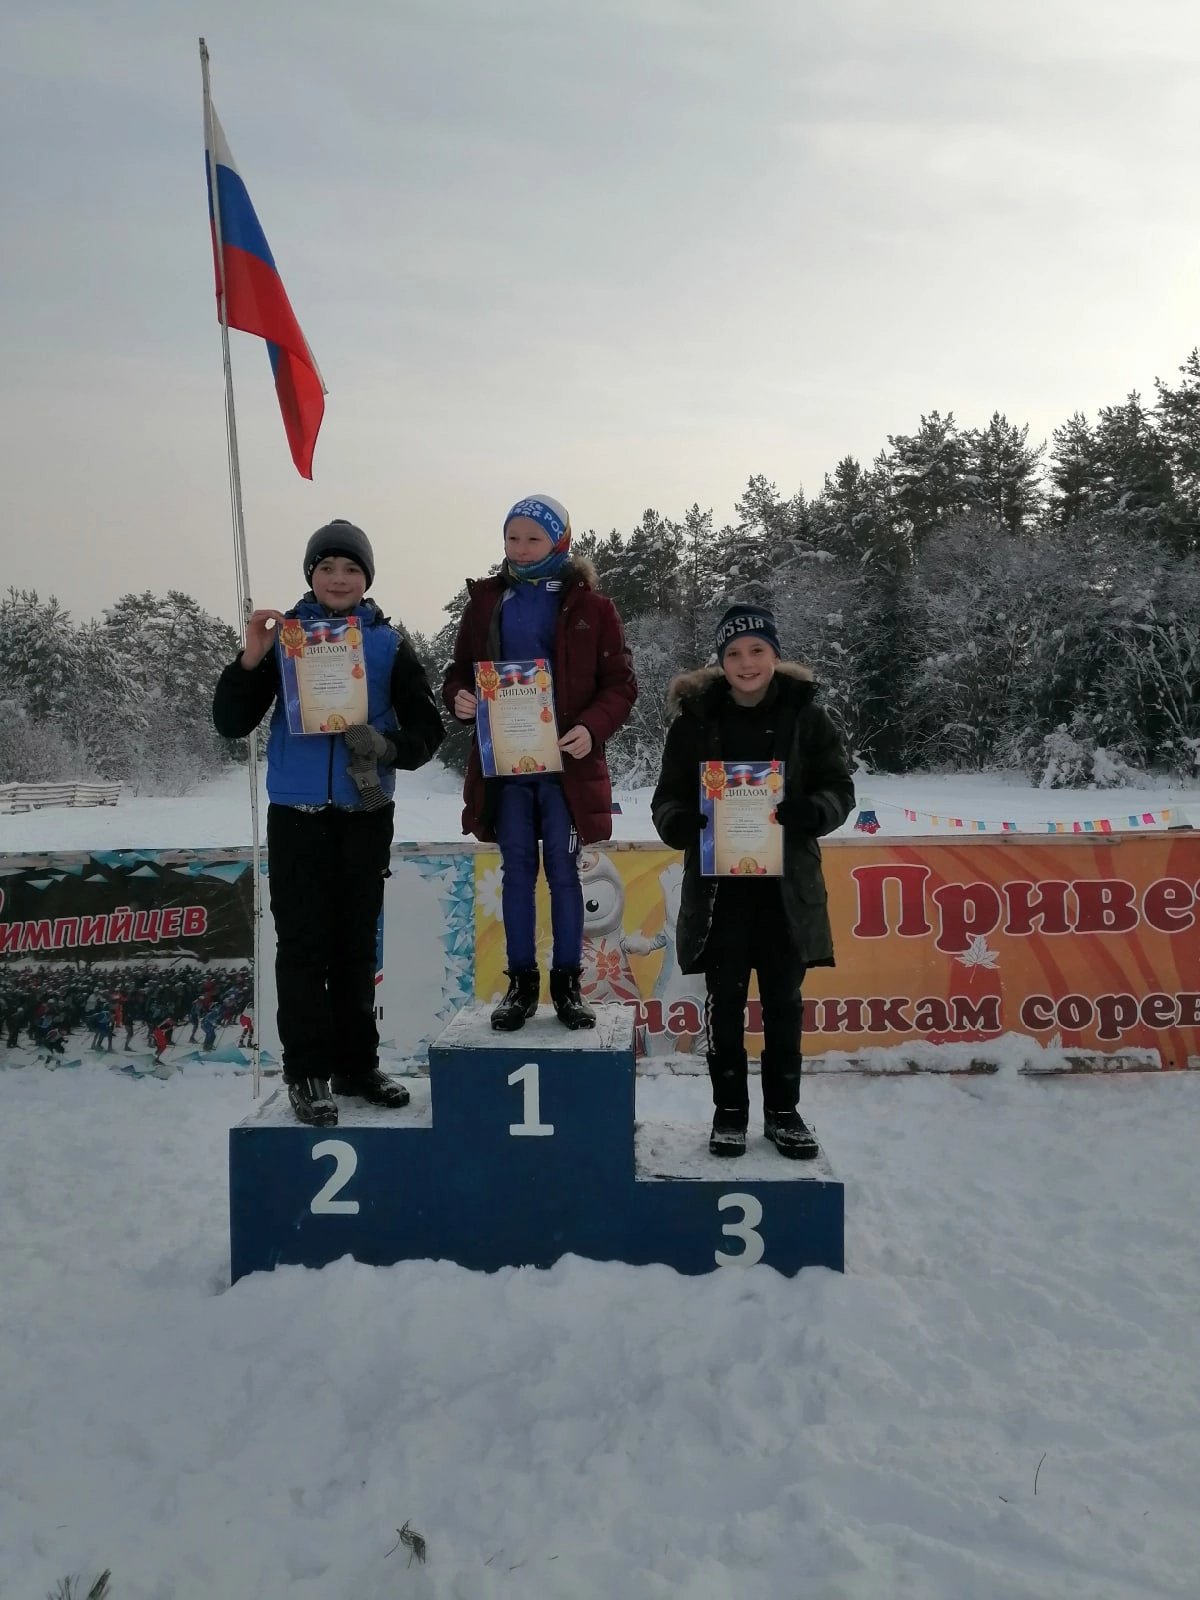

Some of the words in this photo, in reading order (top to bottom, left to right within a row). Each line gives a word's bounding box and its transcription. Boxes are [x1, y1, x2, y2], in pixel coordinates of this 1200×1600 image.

[306, 645, 348, 655] ДИПЛОМ
[499, 687, 537, 698] ДИПЛОМ
[725, 788, 768, 797] ДИПЛОМ
[851, 863, 1200, 954] Приве
[507, 1063, 555, 1136] 1
[310, 1139, 360, 1215] 2
[714, 1193, 766, 1268] 3
